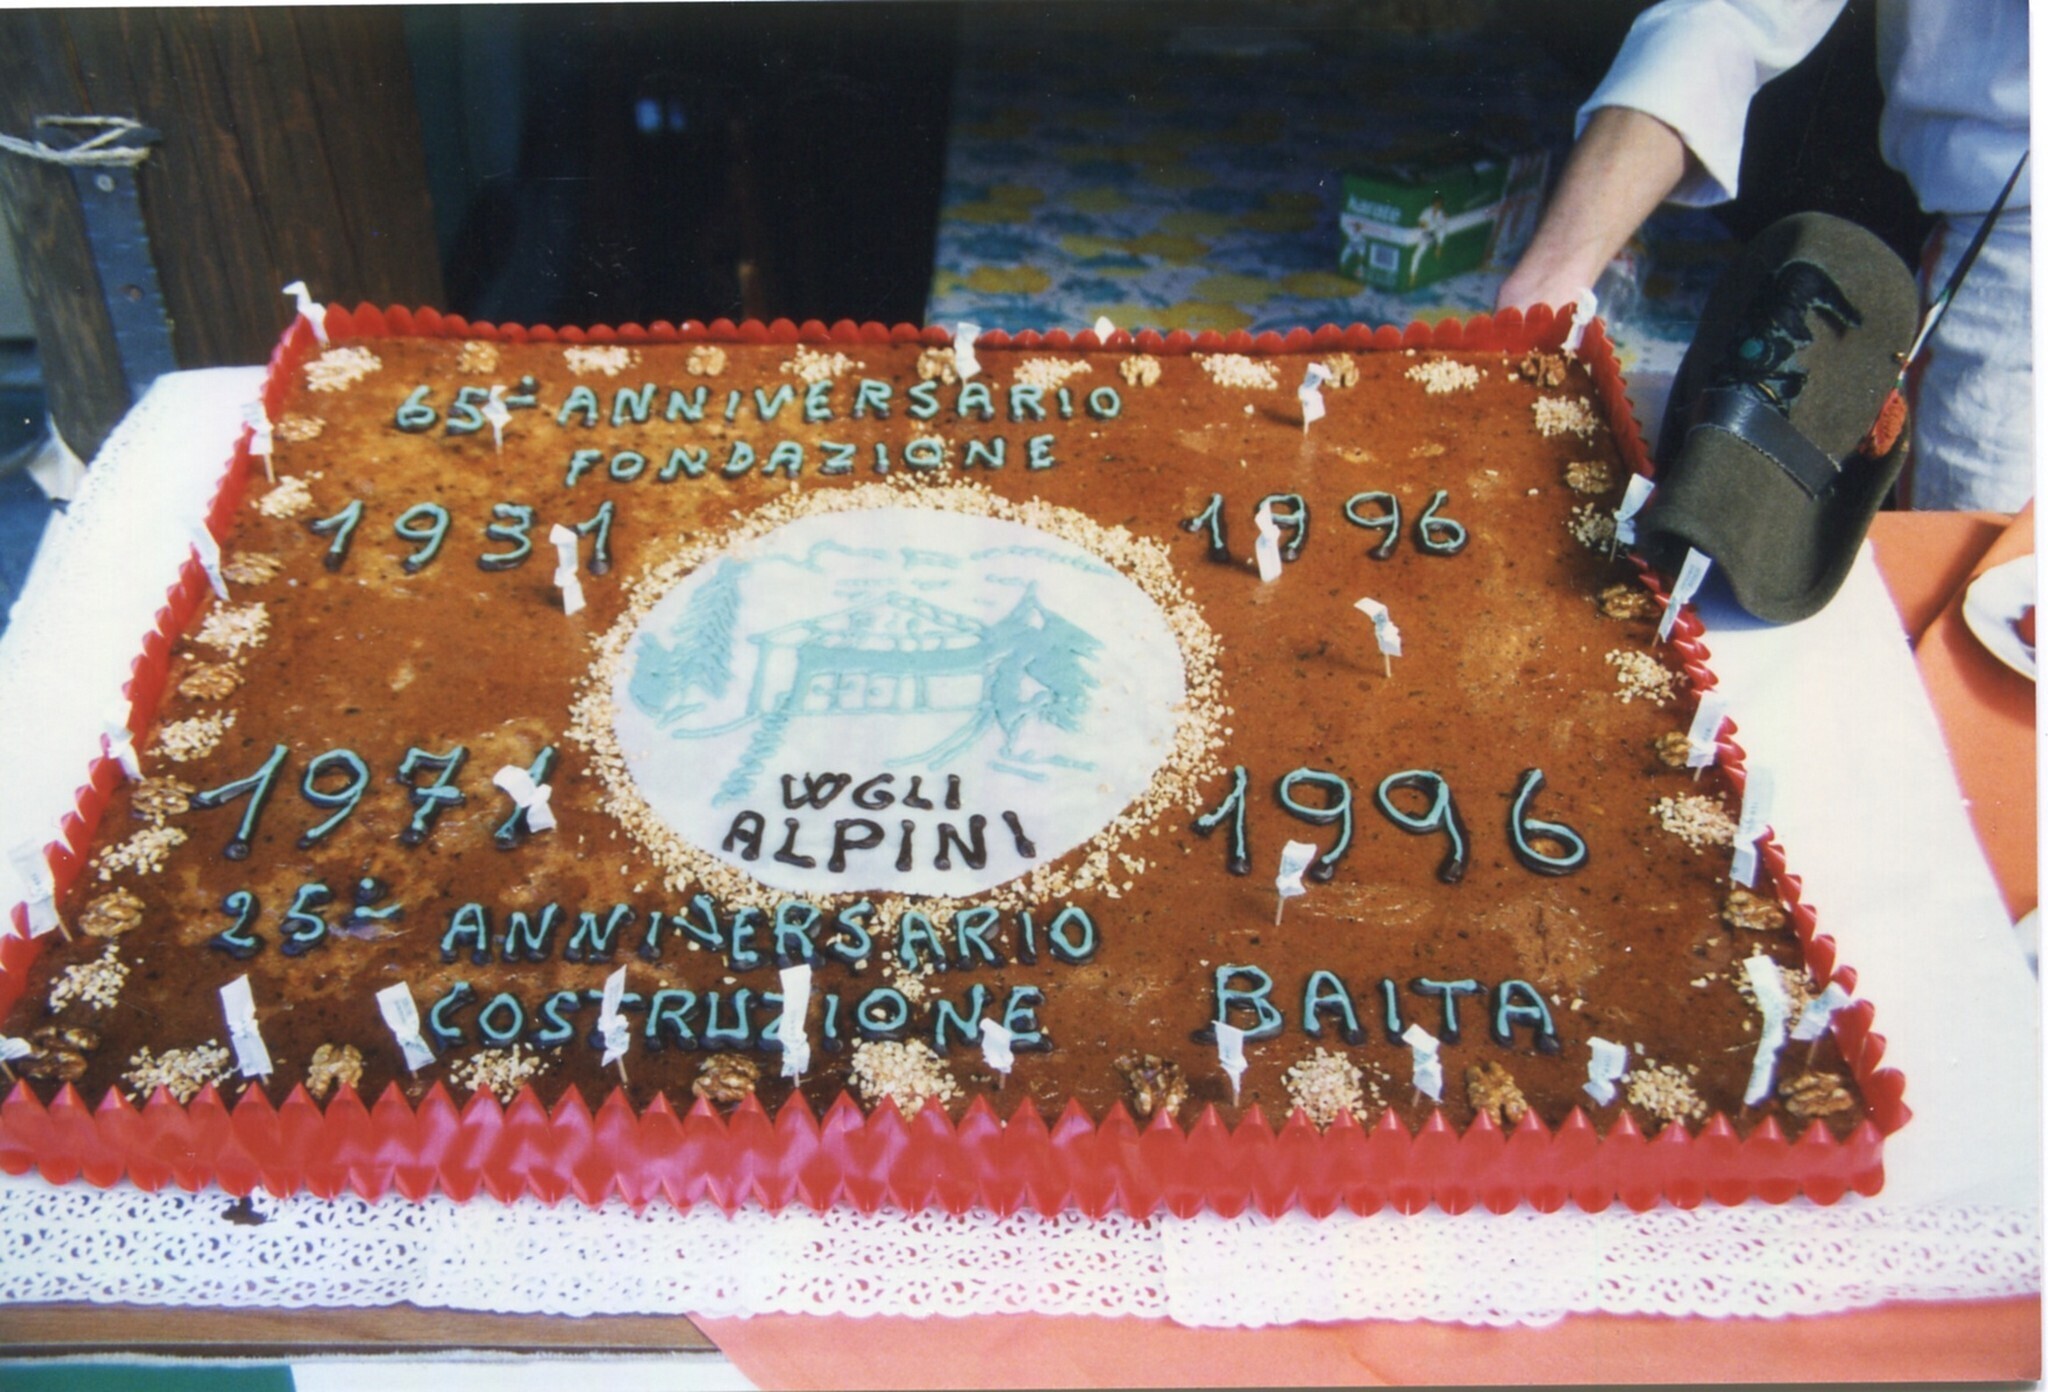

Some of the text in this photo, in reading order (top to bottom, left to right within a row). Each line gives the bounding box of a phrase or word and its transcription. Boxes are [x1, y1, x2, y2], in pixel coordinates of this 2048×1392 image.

[554, 376, 1124, 428] ANNIVERSARIO
[564, 433, 1058, 488] FONDAZIONE
[309, 498, 616, 574] 1931
[1180, 488, 1470, 562] 1996
[721, 809, 1037, 873] ALPINI
[1191, 764, 1590, 884] 1996
[438, 890, 1102, 973] ANNIVERSARIO
[1190, 963, 1563, 1055] BAITA
